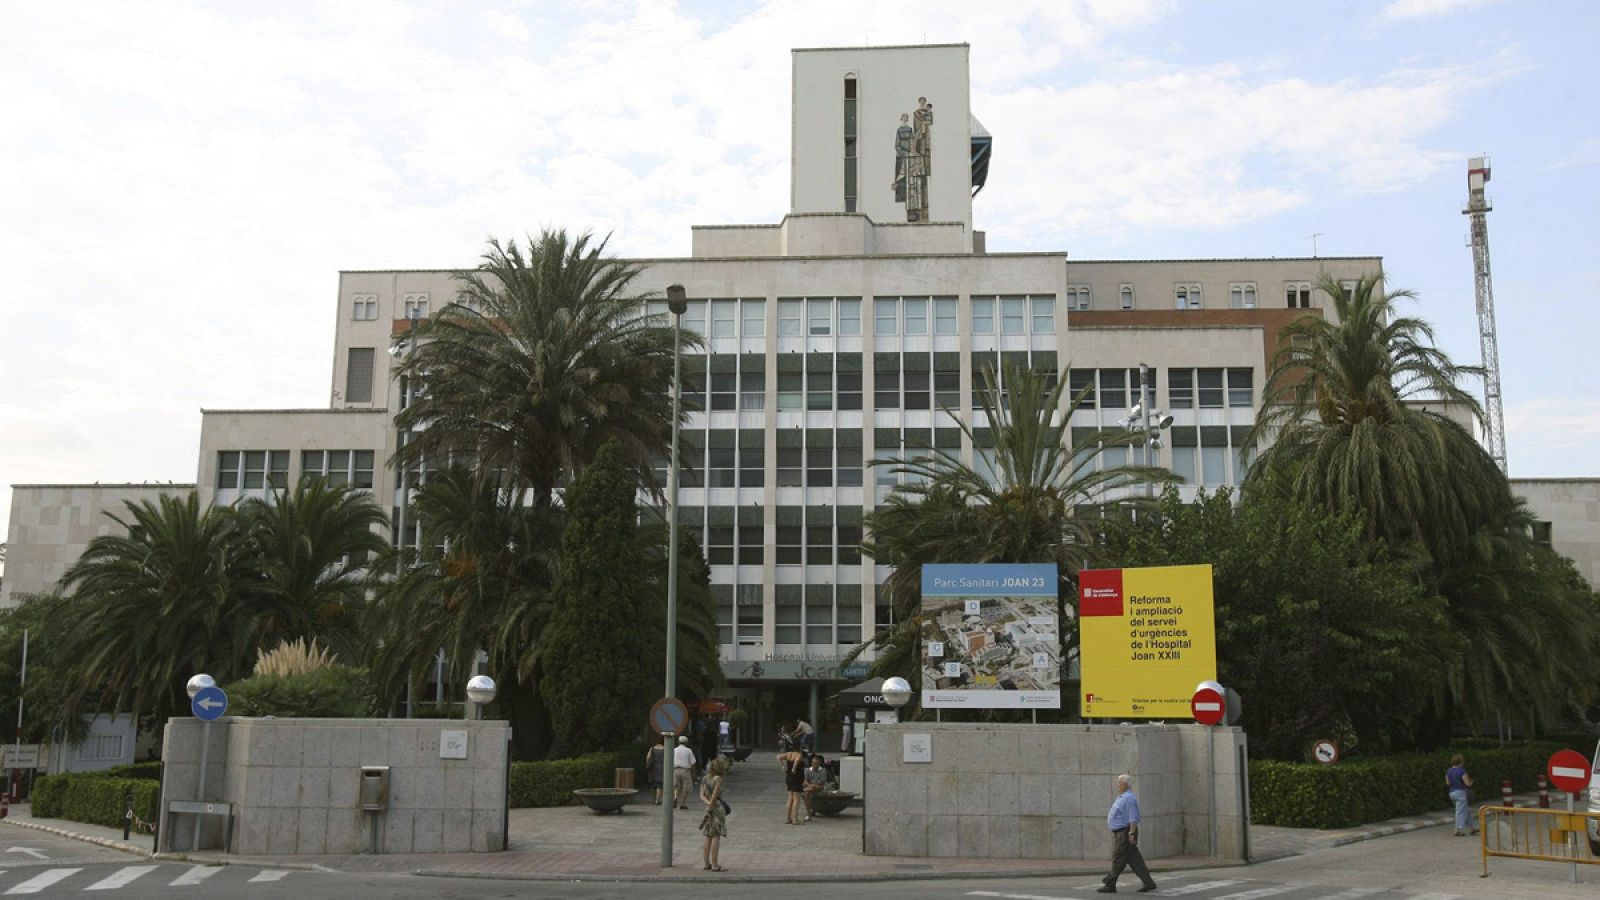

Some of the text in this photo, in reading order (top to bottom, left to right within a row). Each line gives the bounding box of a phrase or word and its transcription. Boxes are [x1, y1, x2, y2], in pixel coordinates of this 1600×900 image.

[934, 577, 1045, 588] Parc Sanitari JOAN 23
[1130, 595, 1171, 604] Reforma
[970, 602, 977, 610] D
[1136, 605, 1183, 616] ampliació
[1130, 617, 1177, 626] del servei
[1130, 628, 1188, 639] d'urgències
[934, 643, 941, 651] C
[1130, 639, 1192, 650] de l'Hospital
[765, 652, 803, 663] Hospital
[1038, 655, 1045, 663] A
[1131, 651, 1181, 661] Joan XXIII
[863, 695, 885, 704] ONC
